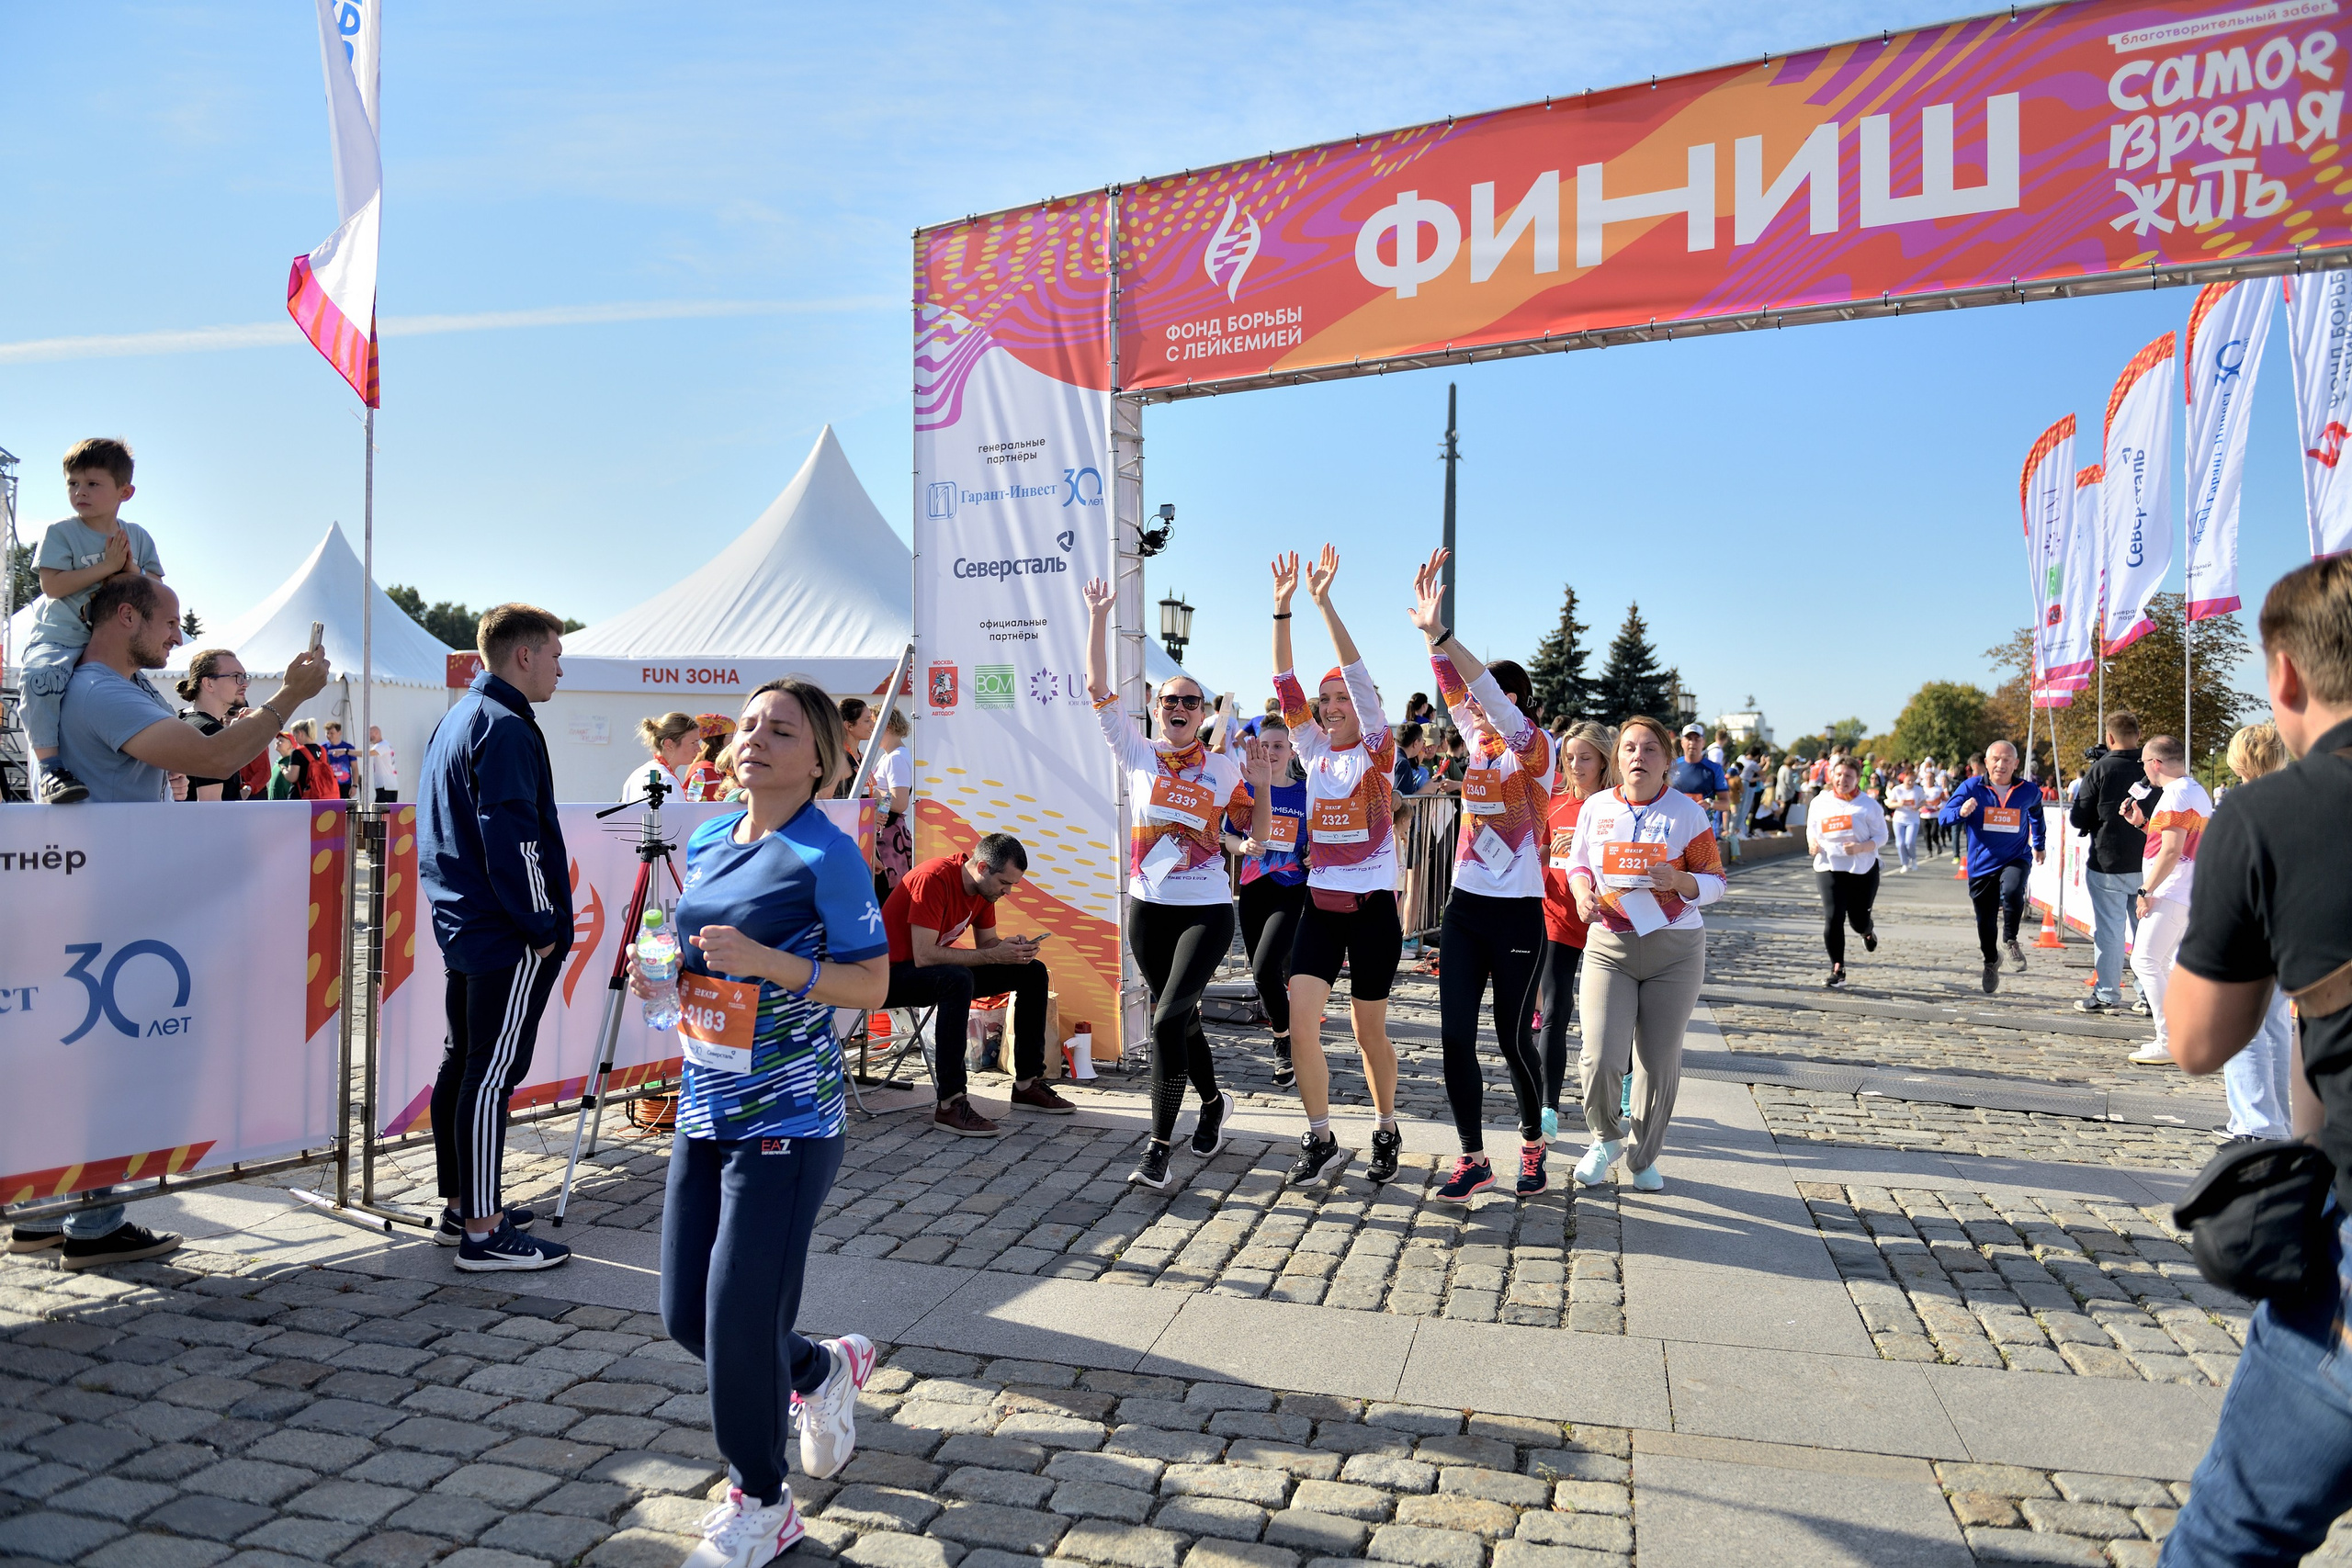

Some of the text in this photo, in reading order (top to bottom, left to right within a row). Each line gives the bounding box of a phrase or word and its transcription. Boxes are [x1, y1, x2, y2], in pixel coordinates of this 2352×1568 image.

[2120, 1, 2328, 46] благотворительный забег
[1354, 91, 2019, 300] ФИНИШ
[2329, 270, 2346, 339] БОРЬБ
[1165, 305, 1303, 342] ФОНД БОРЬБЫ
[1165, 324, 1303, 362] С ЛЕЙКЕМИЕЙ
[978, 438, 1046, 454] генеральные
[987, 451, 1038, 465] партнёры
[961, 484, 1057, 505] Гарант-Инвест
[1062, 467, 1103, 508] 30
[953, 556, 1068, 583] Северсталь
[979, 618, 1047, 630] официальные
[989, 631, 1039, 643] партнёры
[642, 668, 741, 684] FUN ЗОНА
[1466, 784, 1487, 796] 2340
[1166, 791, 1198, 808] 2339
[1271, 806, 1305, 818] ОМБАНК
[1321, 813, 1350, 826] 2322
[1993, 815, 2011, 823] 2308
[1272, 827, 1285, 837] 62
[1618, 857, 1648, 869] 2321
[59, 939, 191, 1046] 30
[686, 1003, 726, 1032] 2183
[146, 1016, 192, 1038] лет
[761, 1138, 792, 1151] EA7
